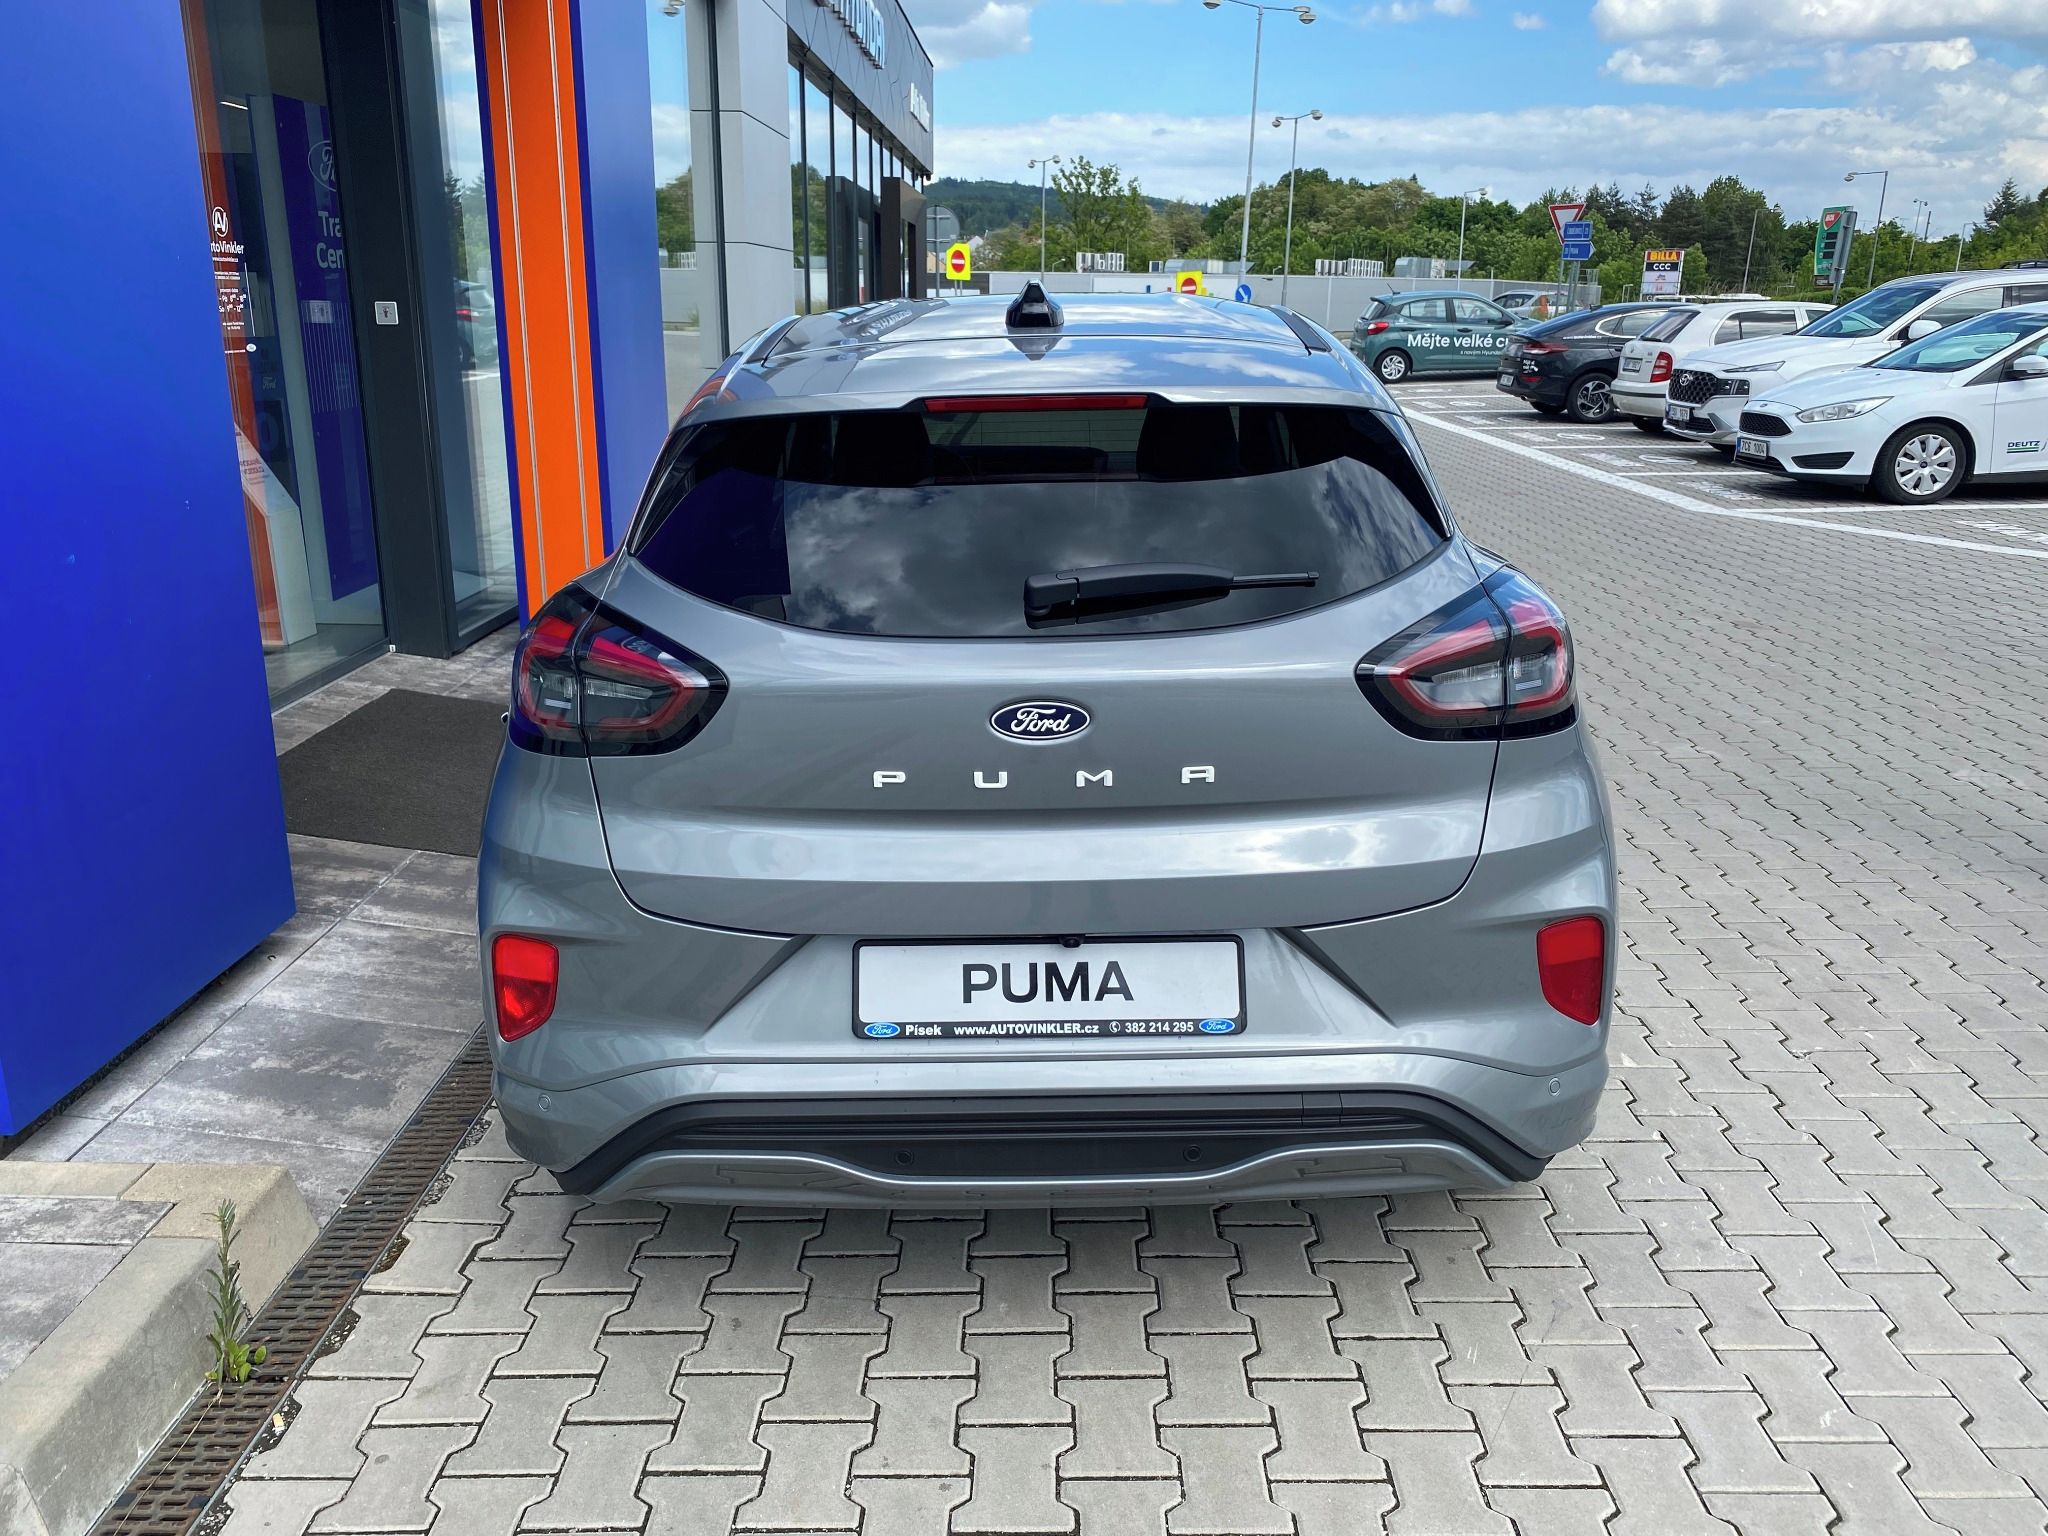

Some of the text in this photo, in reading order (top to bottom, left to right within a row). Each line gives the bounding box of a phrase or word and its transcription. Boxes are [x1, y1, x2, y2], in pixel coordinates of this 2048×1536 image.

[1650, 251, 1678, 261] BILLA
[1407, 333, 1450, 350] Mějte
[1453, 333, 1493, 348] velké
[2007, 440, 2041, 448] DEUTZ
[1010, 707, 1070, 733] Ford
[873, 765, 1215, 789] PUMA
[962, 960, 1134, 1004] PUMA
[872, 1020, 1228, 1036] Ford Písek www.AUTOVINKLER.cz 382 214 295 Ford
